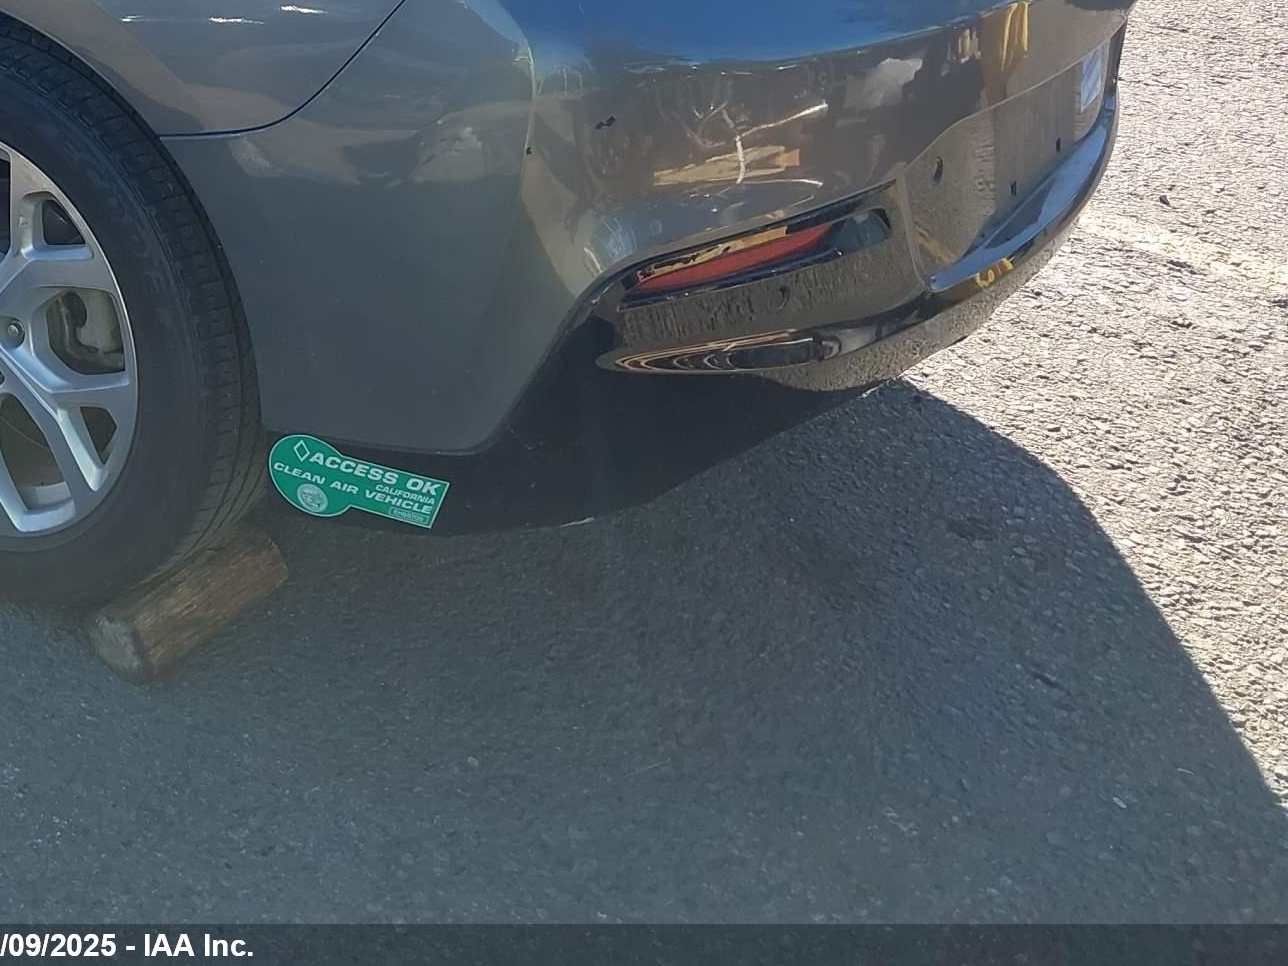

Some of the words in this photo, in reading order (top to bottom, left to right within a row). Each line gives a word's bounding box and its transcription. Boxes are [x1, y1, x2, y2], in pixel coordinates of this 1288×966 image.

[273, 461, 326, 485] CLEAN
[330, 480, 360, 495] AIR
[364, 489, 434, 515] VEHICLE
[310, 452, 399, 485] ACCESS
[406, 478, 442, 496] OK
[375, 484, 436, 505] CALIFORNIA
